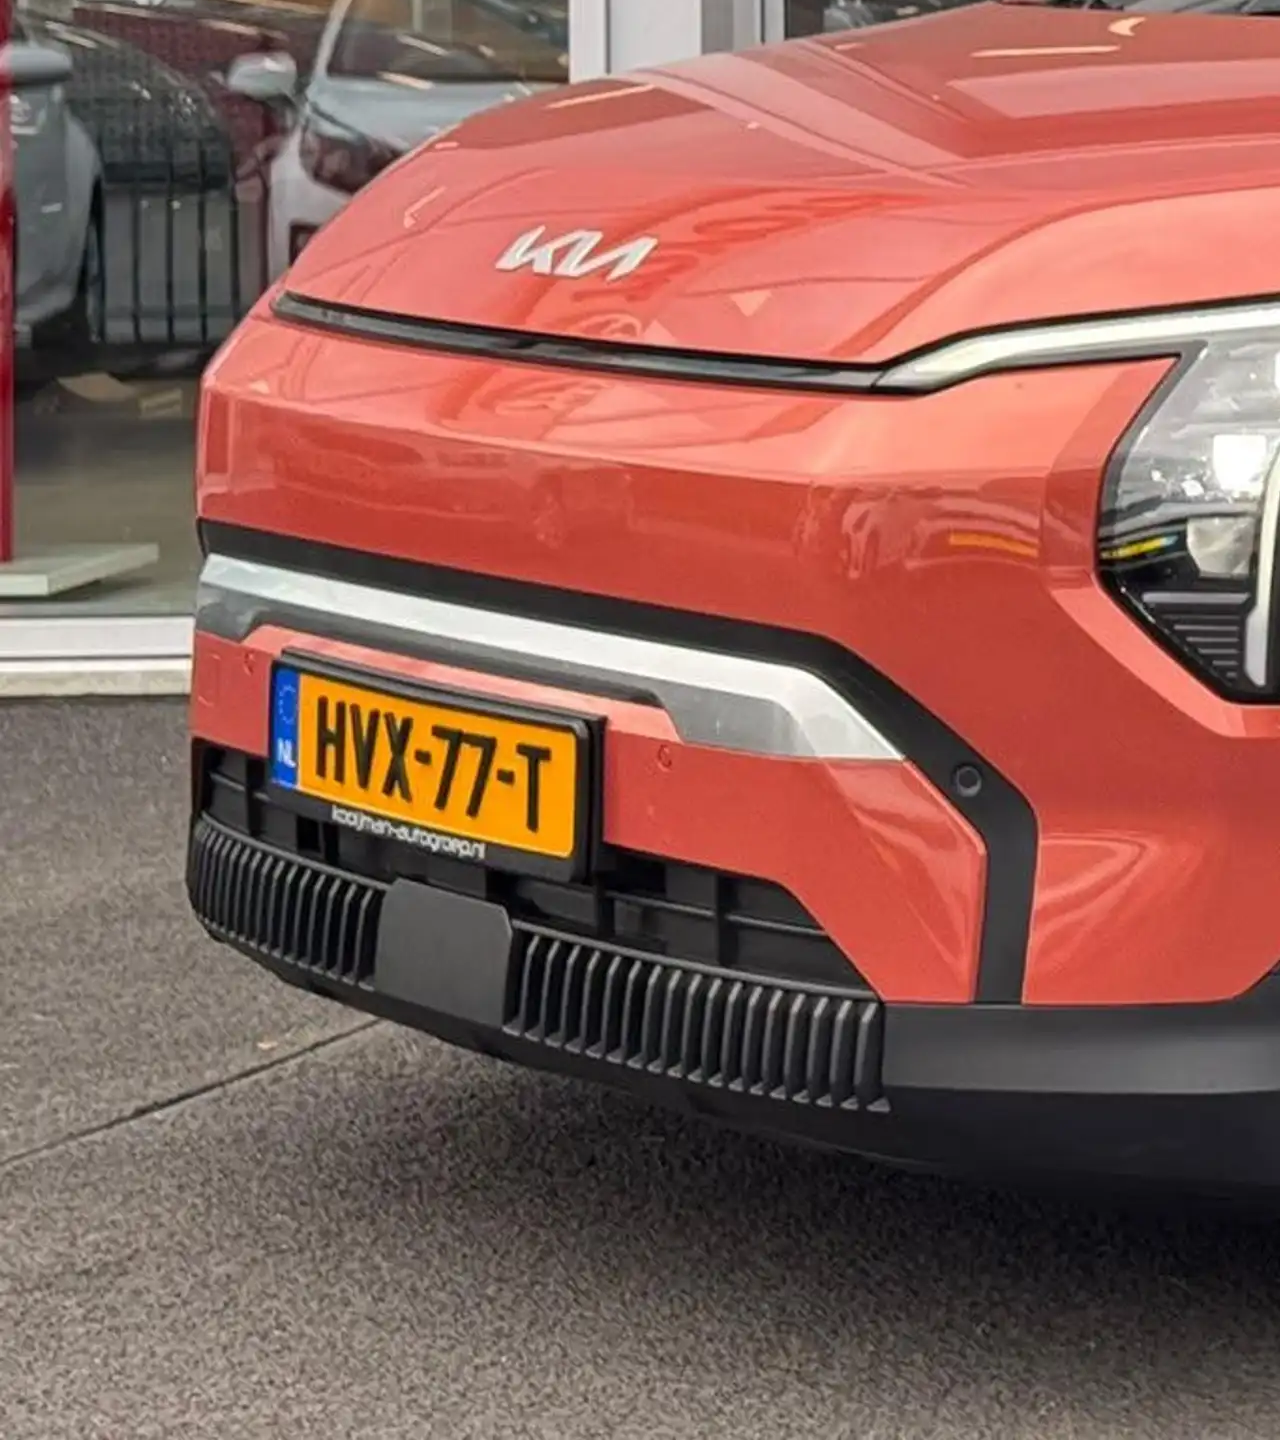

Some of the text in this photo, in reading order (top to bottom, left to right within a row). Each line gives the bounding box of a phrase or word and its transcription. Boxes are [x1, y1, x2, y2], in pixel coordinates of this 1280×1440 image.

[495, 224, 658, 282] KIA
[276, 737, 297, 769] NL
[315, 695, 552, 834] HVX-77-T
